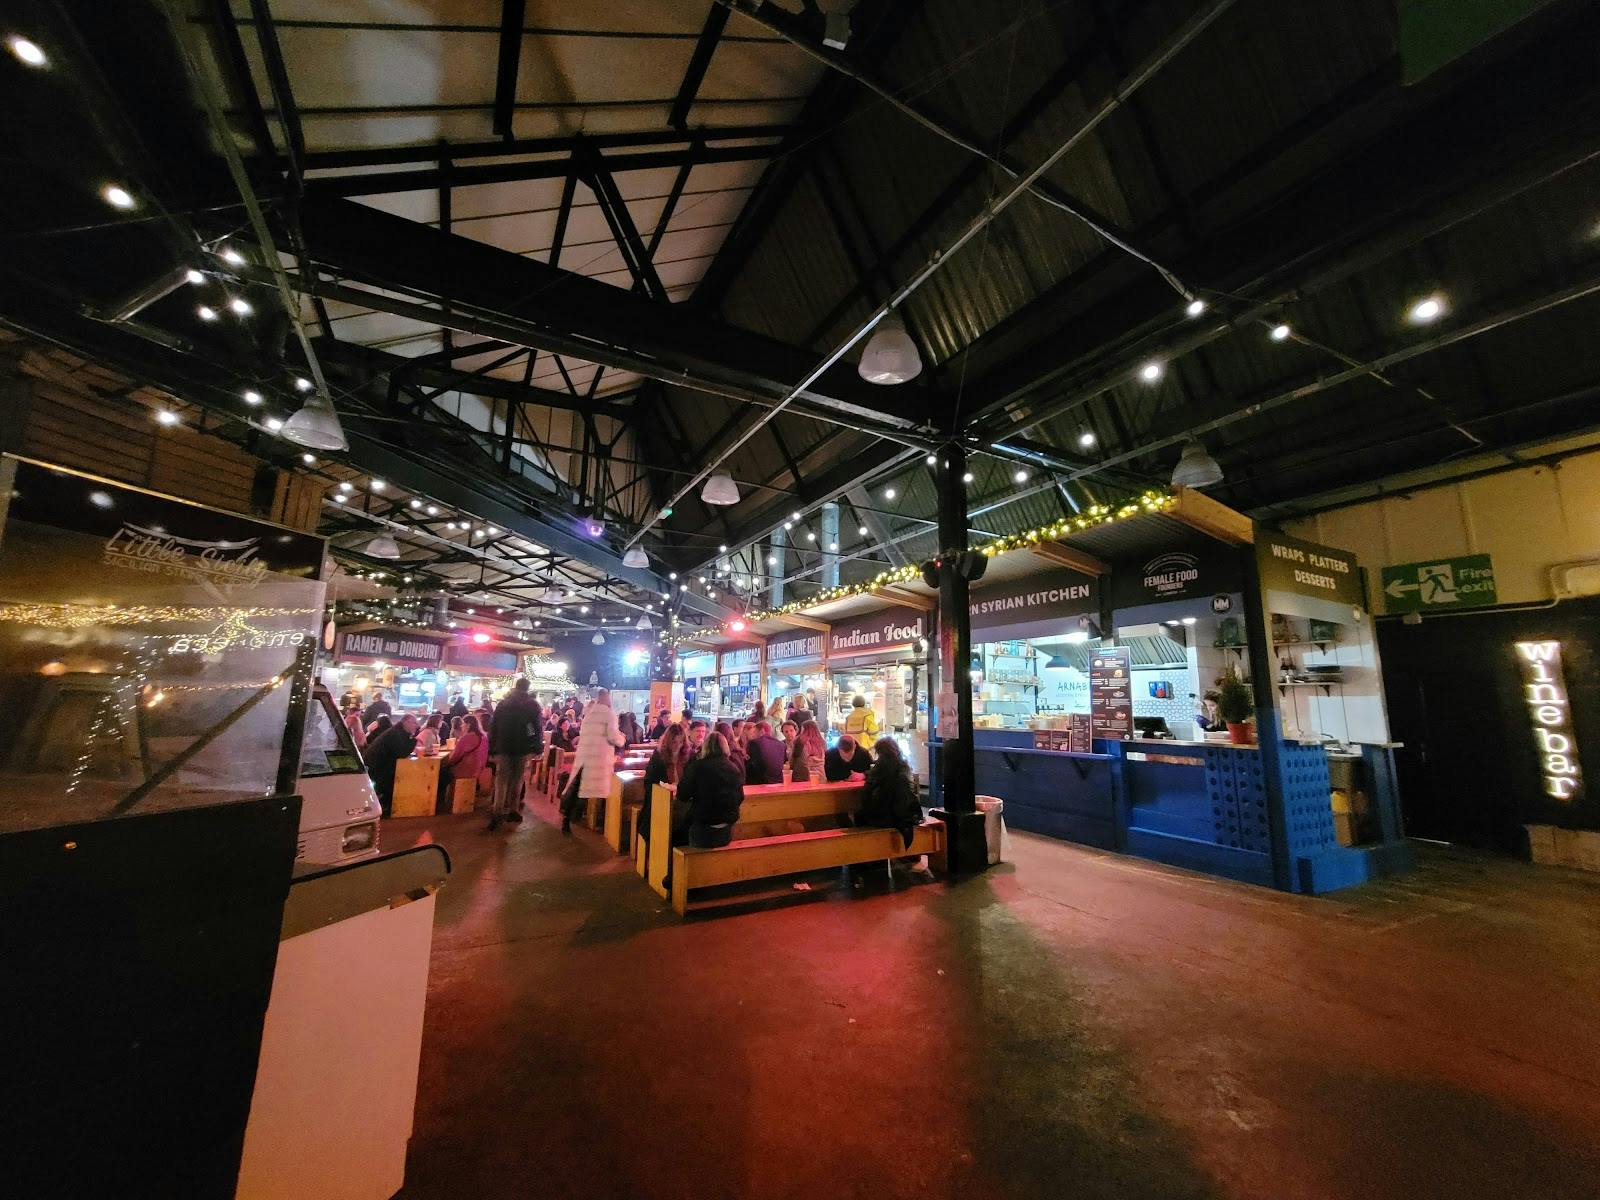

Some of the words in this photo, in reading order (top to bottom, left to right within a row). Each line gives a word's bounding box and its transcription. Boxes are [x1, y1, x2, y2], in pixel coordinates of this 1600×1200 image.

[105, 528, 187, 562] Little
[1271, 543, 1305, 563] WRAPS
[1309, 554, 1349, 573] PLATTERS
[1144, 573, 1175, 587] FEMALE
[1176, 569, 1198, 582] FOOD
[1294, 570, 1336, 590] DESSERTS
[1459, 568, 1492, 580] Fire
[1462, 580, 1494, 592] exit
[981, 595, 1024, 613] SYRIAN
[1027, 584, 1090, 606] KITCHEN
[832, 629, 880, 649] Indian
[883, 617, 922, 641] Food
[345, 633, 384, 654] RAMEN
[384, 641, 398, 653] AND
[399, 640, 439, 660] DONBURI
[767, 643, 776, 660] THE
[777, 638, 807, 659] ARGENTINE
[807, 635, 825, 655] GRILL
